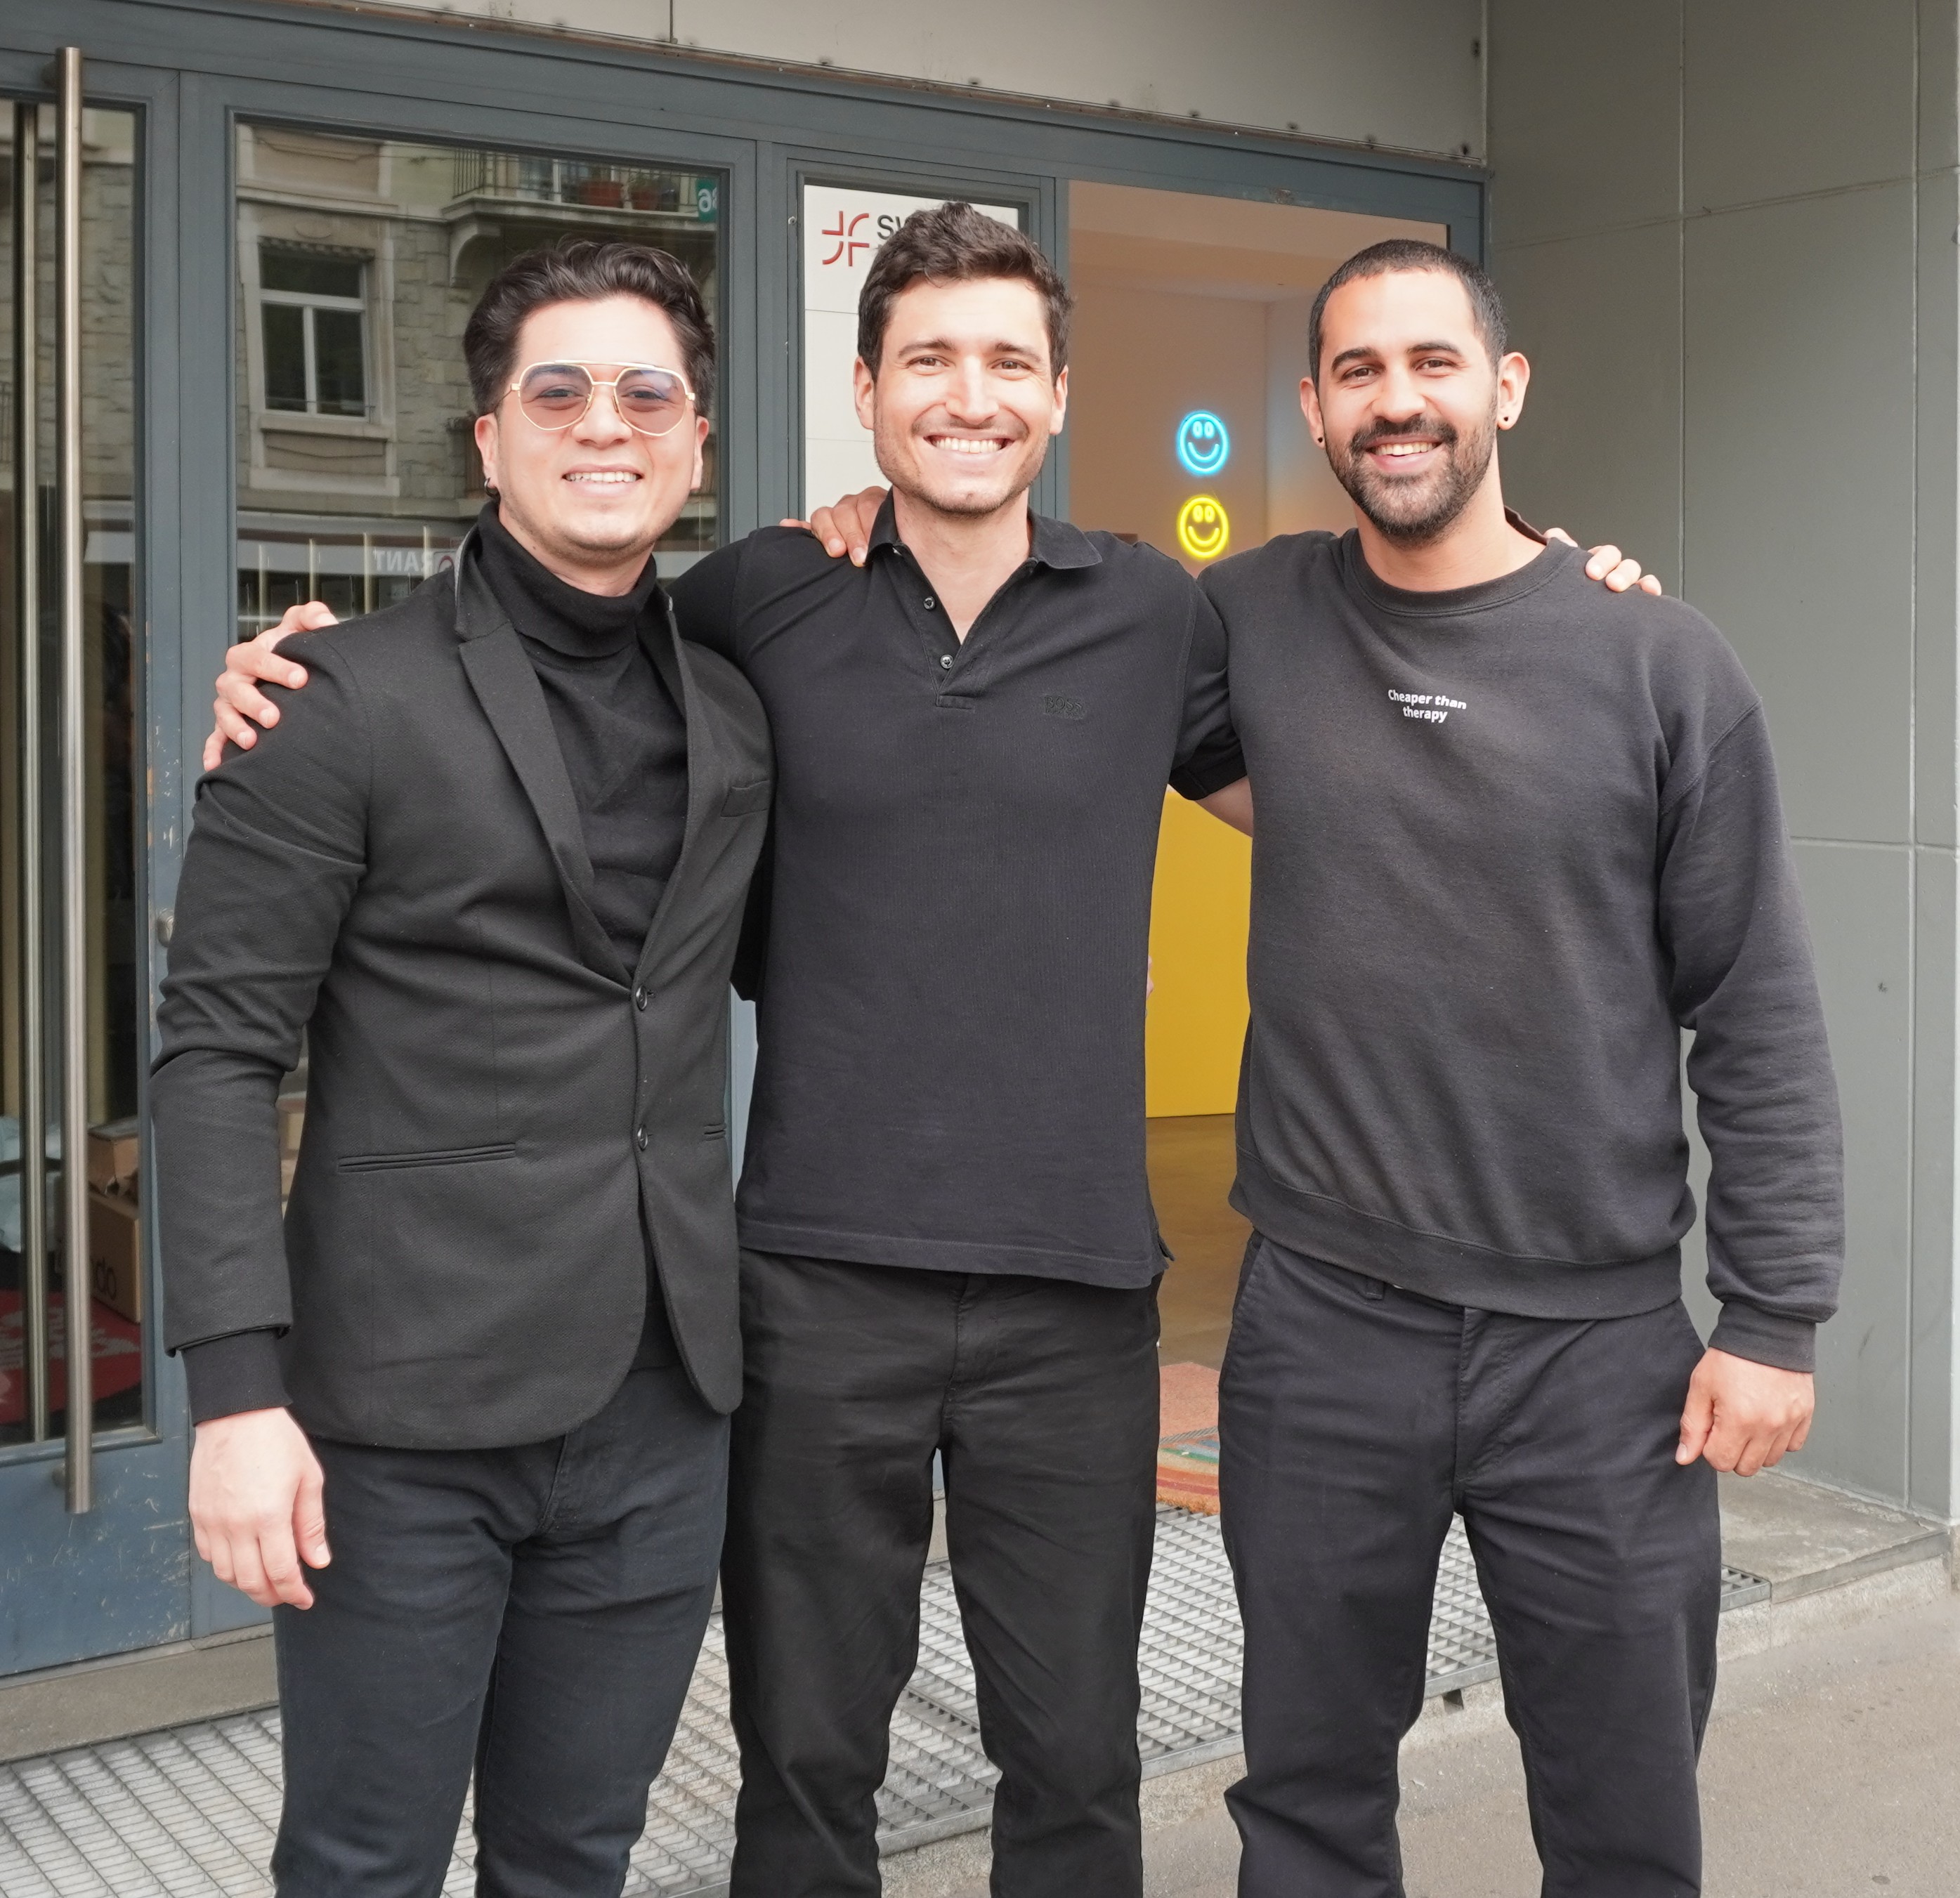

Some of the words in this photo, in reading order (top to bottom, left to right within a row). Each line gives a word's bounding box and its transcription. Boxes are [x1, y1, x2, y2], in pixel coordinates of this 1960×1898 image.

[1045, 695, 1083, 712] BOSS
[1388, 689, 1432, 706] Cheaper
[1435, 695, 1467, 709] than
[1403, 705, 1448, 723] therapy
